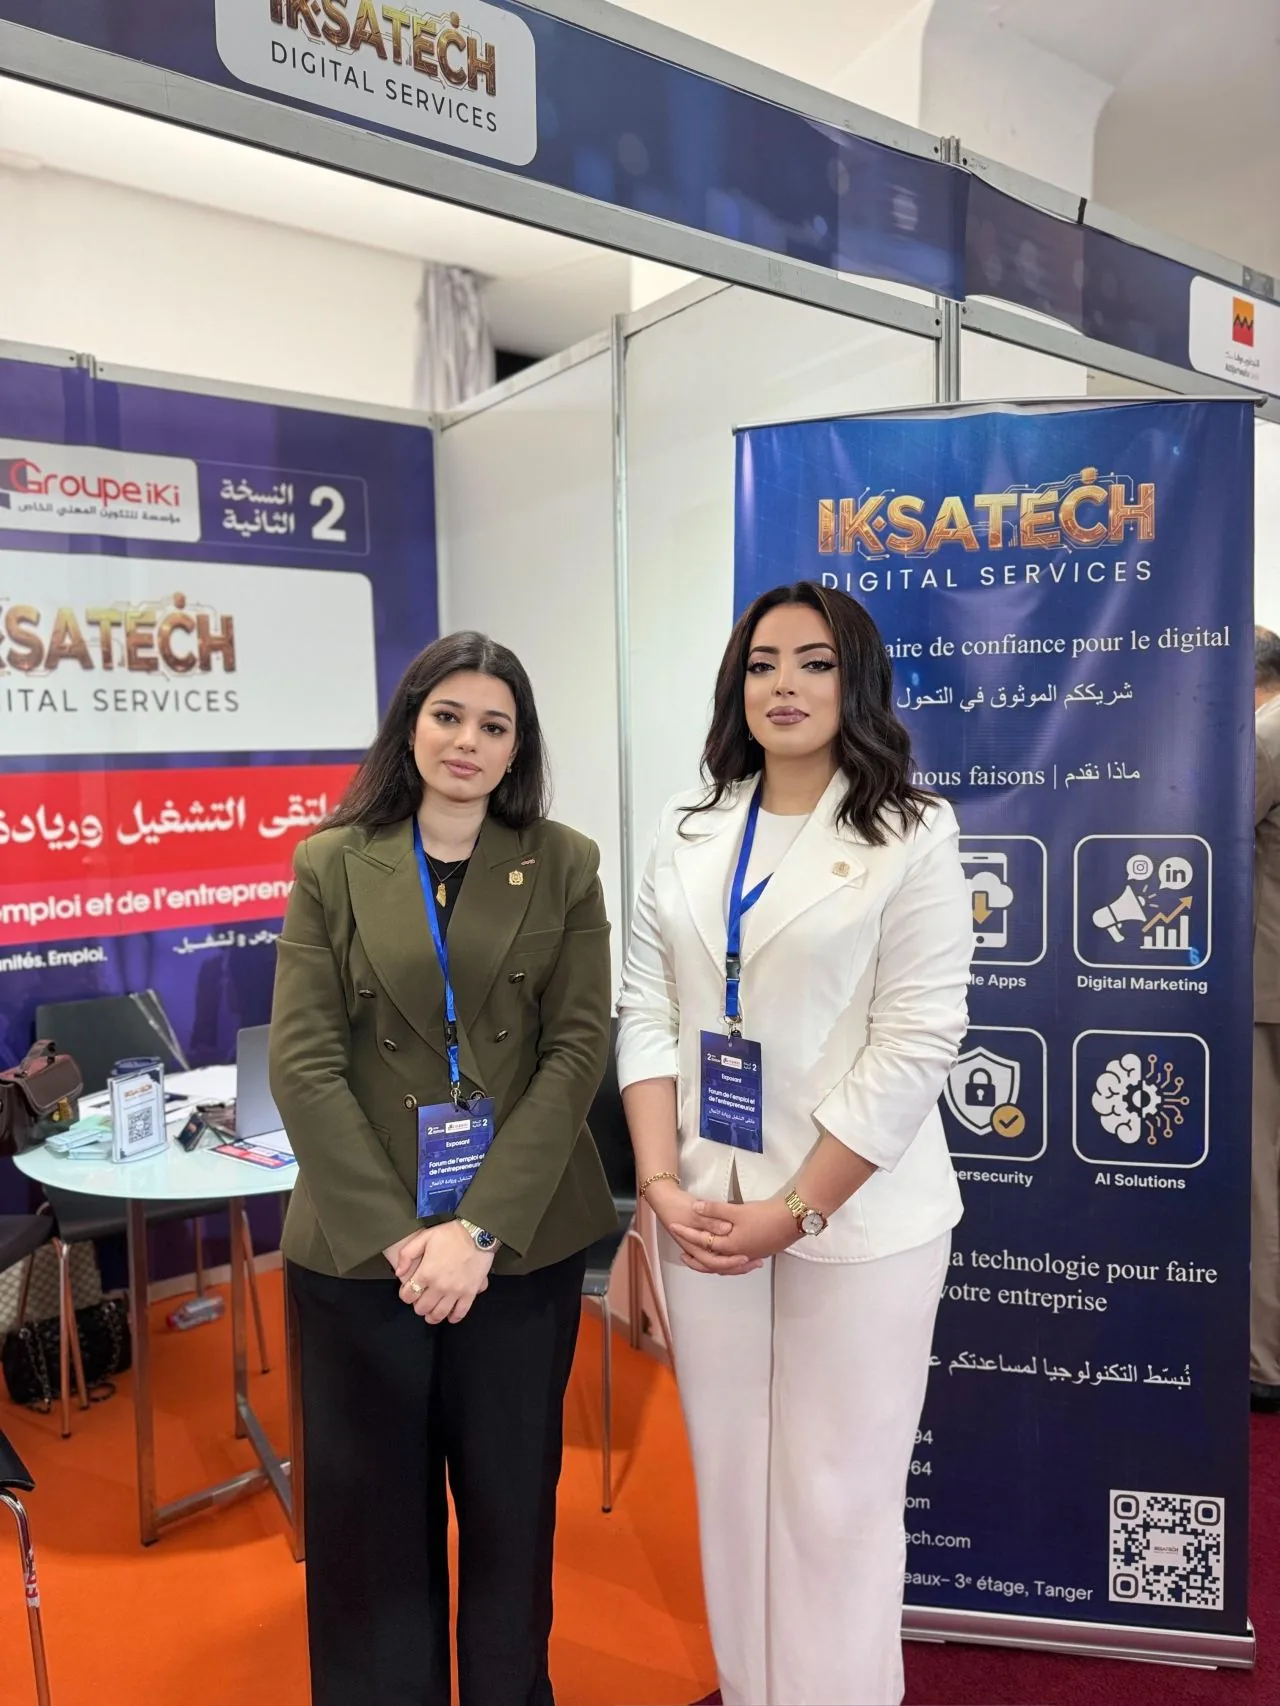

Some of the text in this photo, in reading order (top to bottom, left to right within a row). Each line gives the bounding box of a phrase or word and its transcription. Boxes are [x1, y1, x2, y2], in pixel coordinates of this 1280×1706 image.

[271, 40, 497, 132] DIGITAL SERVICES
[219, 478, 294, 505] النسخة
[222, 508, 295, 538] الثانية
[309, 485, 347, 542] 2
[817, 483, 1155, 555] IKSATECH
[822, 560, 1152, 592] DIGITAL SERVICES
[929, 636, 955, 657] de
[961, 633, 1066, 655] confiance
[1071, 637, 1123, 658] pour
[1130, 630, 1150, 650] le
[1158, 625, 1230, 653] digital
[93, 688, 239, 712] SERVICES
[896, 682, 1133, 713] شريككم الموثوق في التحول
[911, 765, 1045, 786] nous faisons
[1064, 761, 1141, 789] ماذا نقدم
[116, 795, 246, 845] التشغيل
[258, 792, 340, 839] لتقى
[85, 891, 114, 917] et
[117, 890, 151, 915] de
[48, 946, 108, 967] Emploi.
[988, 974, 1027, 991] Apps
[1077, 975, 1208, 994] Digital Marketing
[721, 1073, 742, 1083] Exposant
[445, 1138, 470, 1148] Exposant
[428, 1160, 447, 1168] Forum
[456, 1154, 479, 1164] l'emploi
[429, 1168, 437, 1176] de
[1094, 1172, 1186, 1189] AI Solutions
[948, 1249, 1218, 1284] a technologie pour faire
[998, 1288, 1108, 1313] entreprise
[948, 1351, 1037, 1376] لمساعدتكم
[1043, 1357, 1138, 1386] التكنولوجيا
[976, 1575, 1029, 1597] étage,
[1034, 1580, 1094, 1602] Tanger
